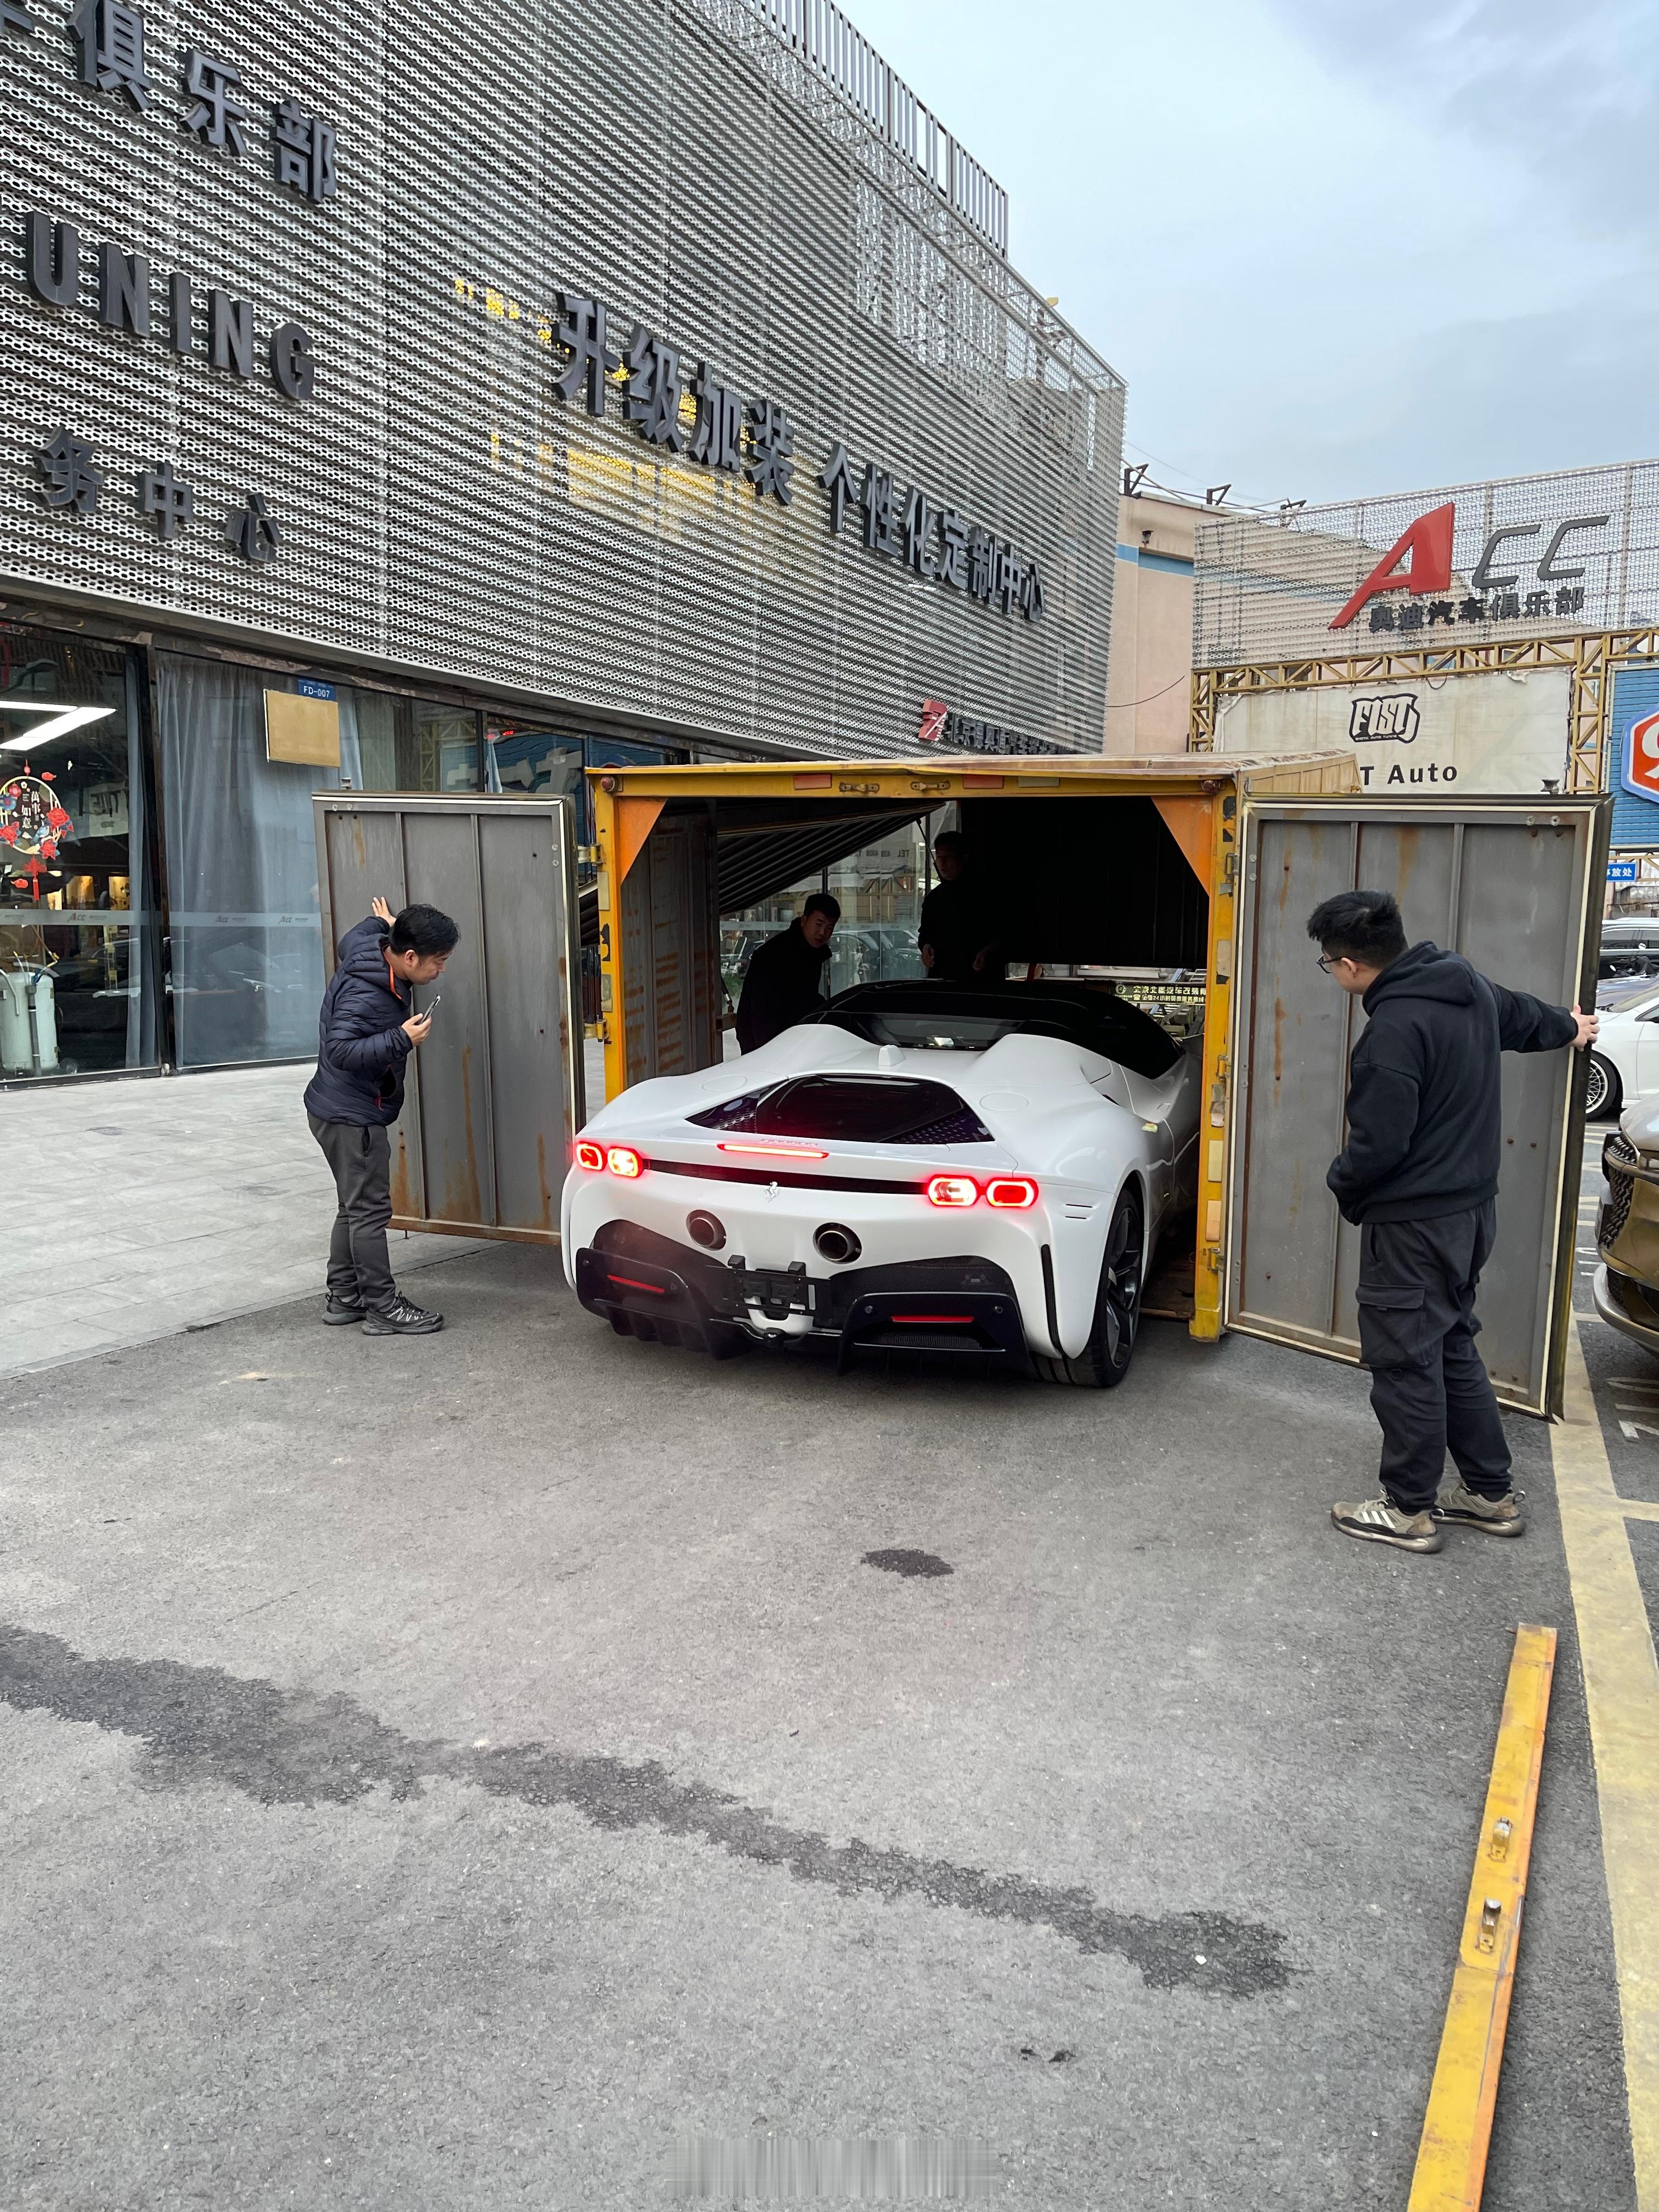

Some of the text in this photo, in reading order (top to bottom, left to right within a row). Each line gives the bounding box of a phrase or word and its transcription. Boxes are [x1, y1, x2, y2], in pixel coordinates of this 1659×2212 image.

[0, 0, 337, 203] 俱乐部
[26, 212, 315, 400] UNING
[35, 425, 283, 562] 务中心
[551, 292, 1044, 623] 升级加装 个性化定制中心
[1328, 502, 1609, 630] ACC
[1368, 586, 1584, 633] 奥迪汽车俱乐部
[303, 685, 330, 698] FD-007
[1387, 763, 1457, 785] Auto
